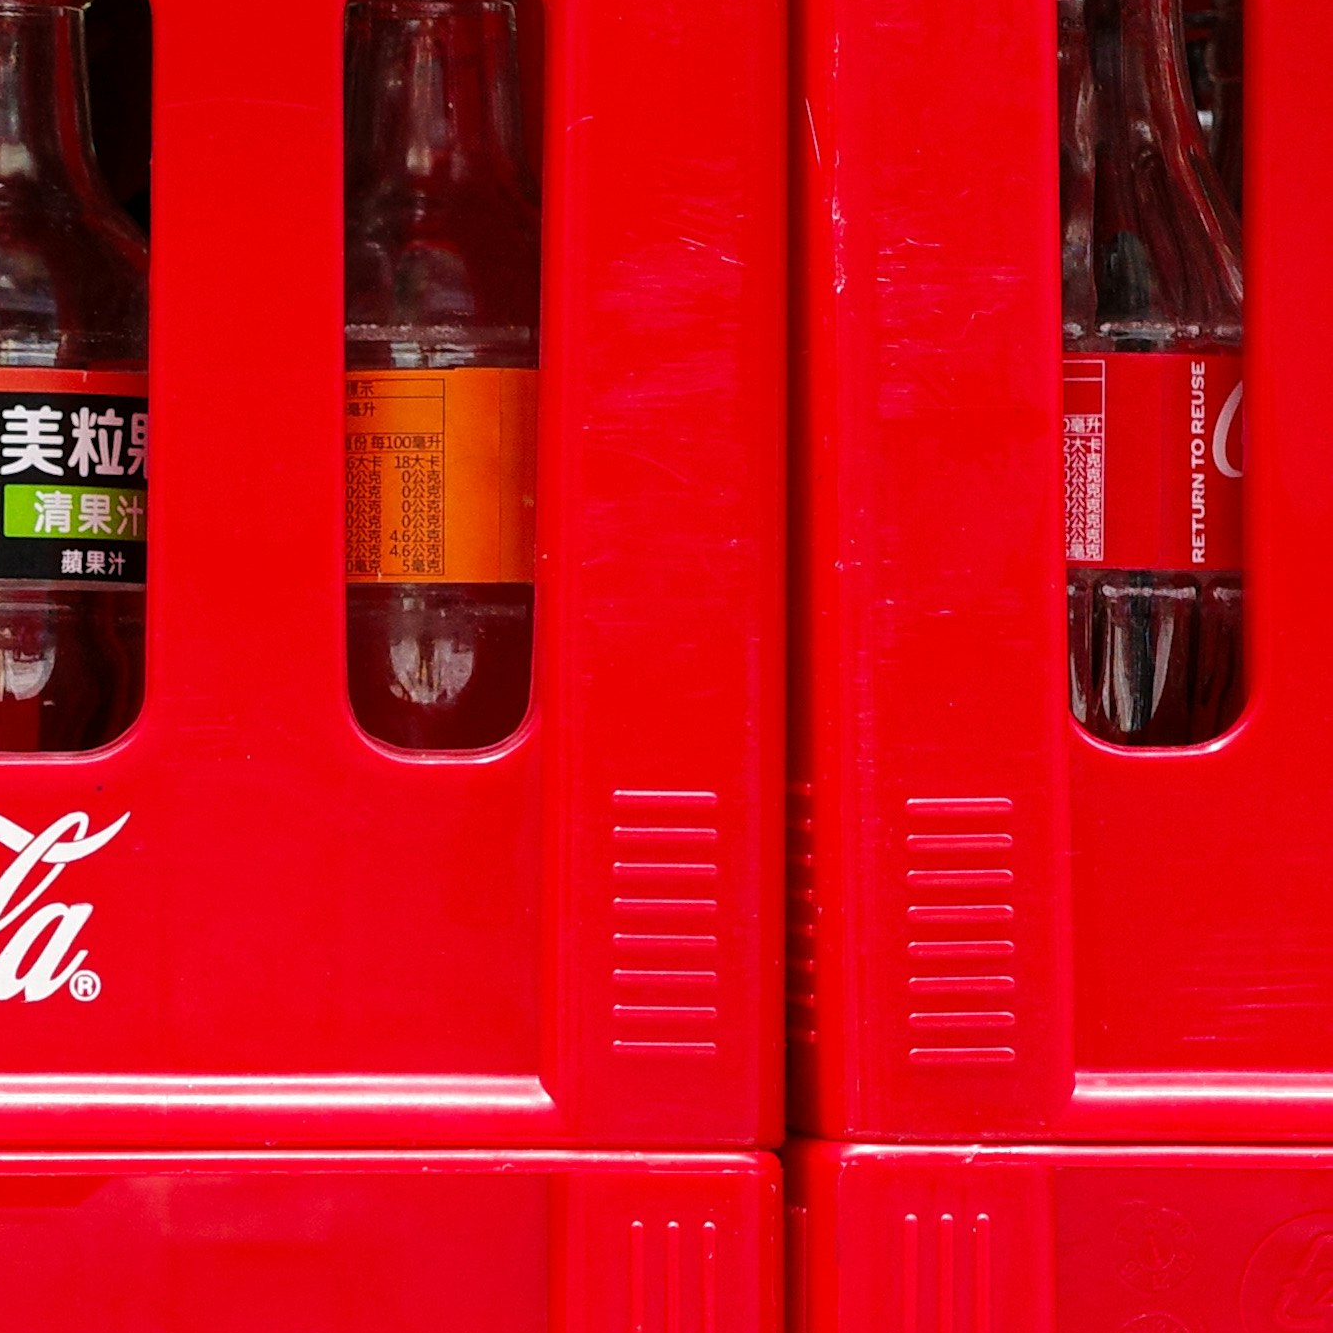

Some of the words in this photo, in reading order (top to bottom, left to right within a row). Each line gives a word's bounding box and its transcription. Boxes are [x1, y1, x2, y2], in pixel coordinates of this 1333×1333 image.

[1191, 360, 1205, 434] REUSE
[1191, 438, 1205, 468] TO
[394, 455, 442, 470] 18大卡
[402, 470, 442, 485] 0公克
[402, 485, 442, 499] 0公克
[33, 490, 144, 536] 清果汁
[402, 500, 442, 514] 0公克
[402, 515, 442, 529] 0公克
[1191, 473, 1205, 564] RETURN
[389, 530, 442, 544] 4.6公克
[389, 544, 442, 559] 4.6公克
[61, 549, 127, 576] 蘋果汁
